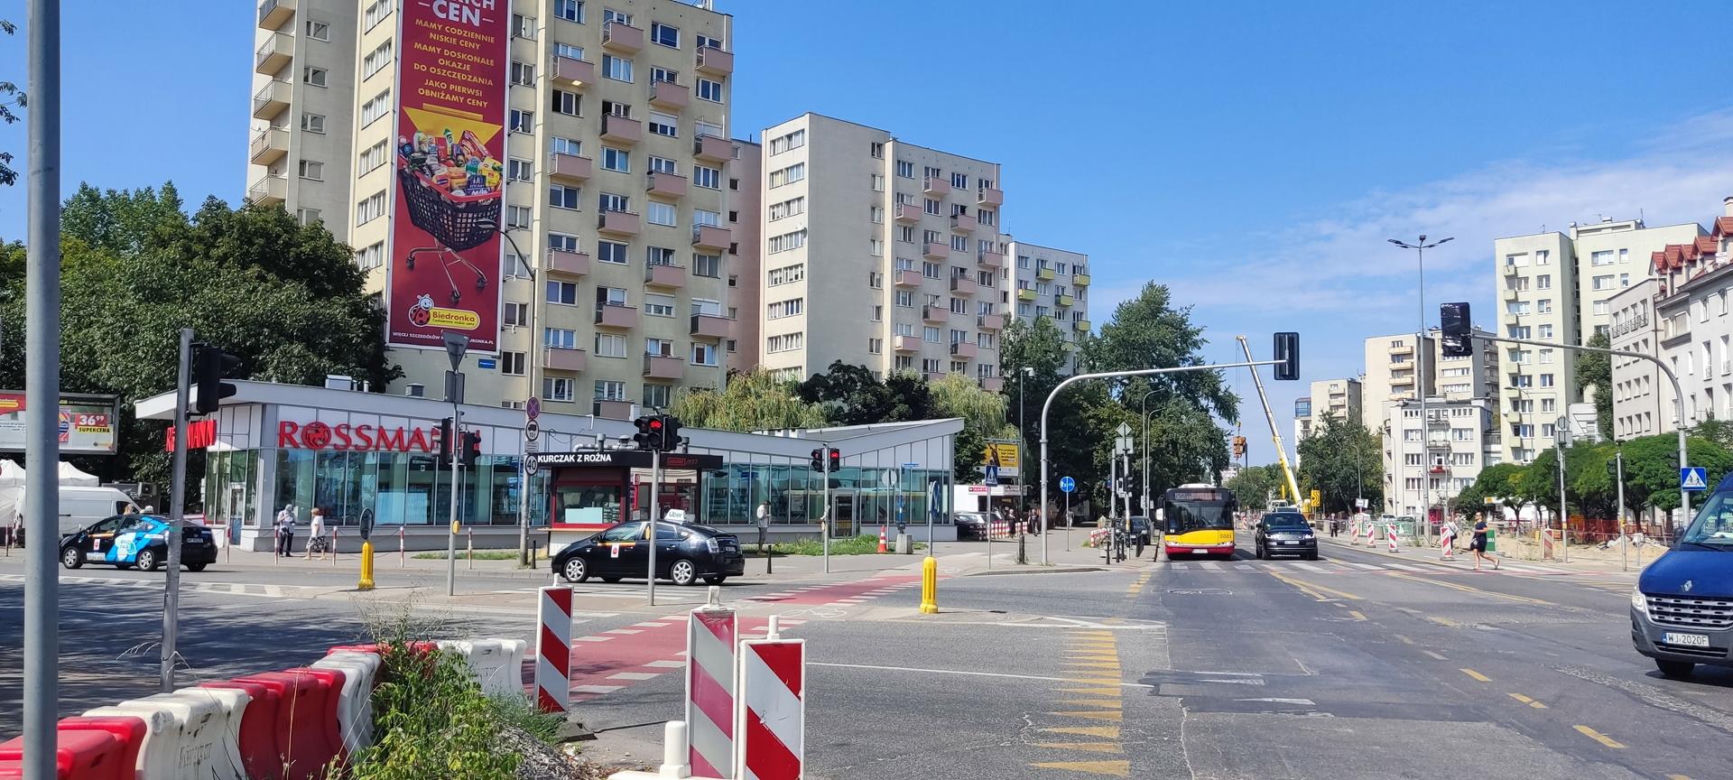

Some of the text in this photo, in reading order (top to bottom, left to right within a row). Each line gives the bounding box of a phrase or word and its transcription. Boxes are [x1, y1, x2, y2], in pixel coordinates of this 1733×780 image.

[432, 0, 480, 27] CEN
[415, 19, 495, 43] MAMY CODZIENNIE
[429, 32, 481, 50] NISKIE CENY
[414, 42, 495, 67] MAMY DOSKONALE
[413, 62, 493, 86] DO OSZCZĘDZANIA
[438, 58, 471, 71] OKAZJE
[418, 87, 489, 108] OBNIŻAMY CENY
[424, 79, 483, 97] JAKO PIERWSI
[432, 311, 475, 322] Biedronka
[278, 420, 481, 453] ROSSMA
[526, 459, 536, 470] 40
[537, 453, 612, 463] KURCZAK Z ROŻNA
